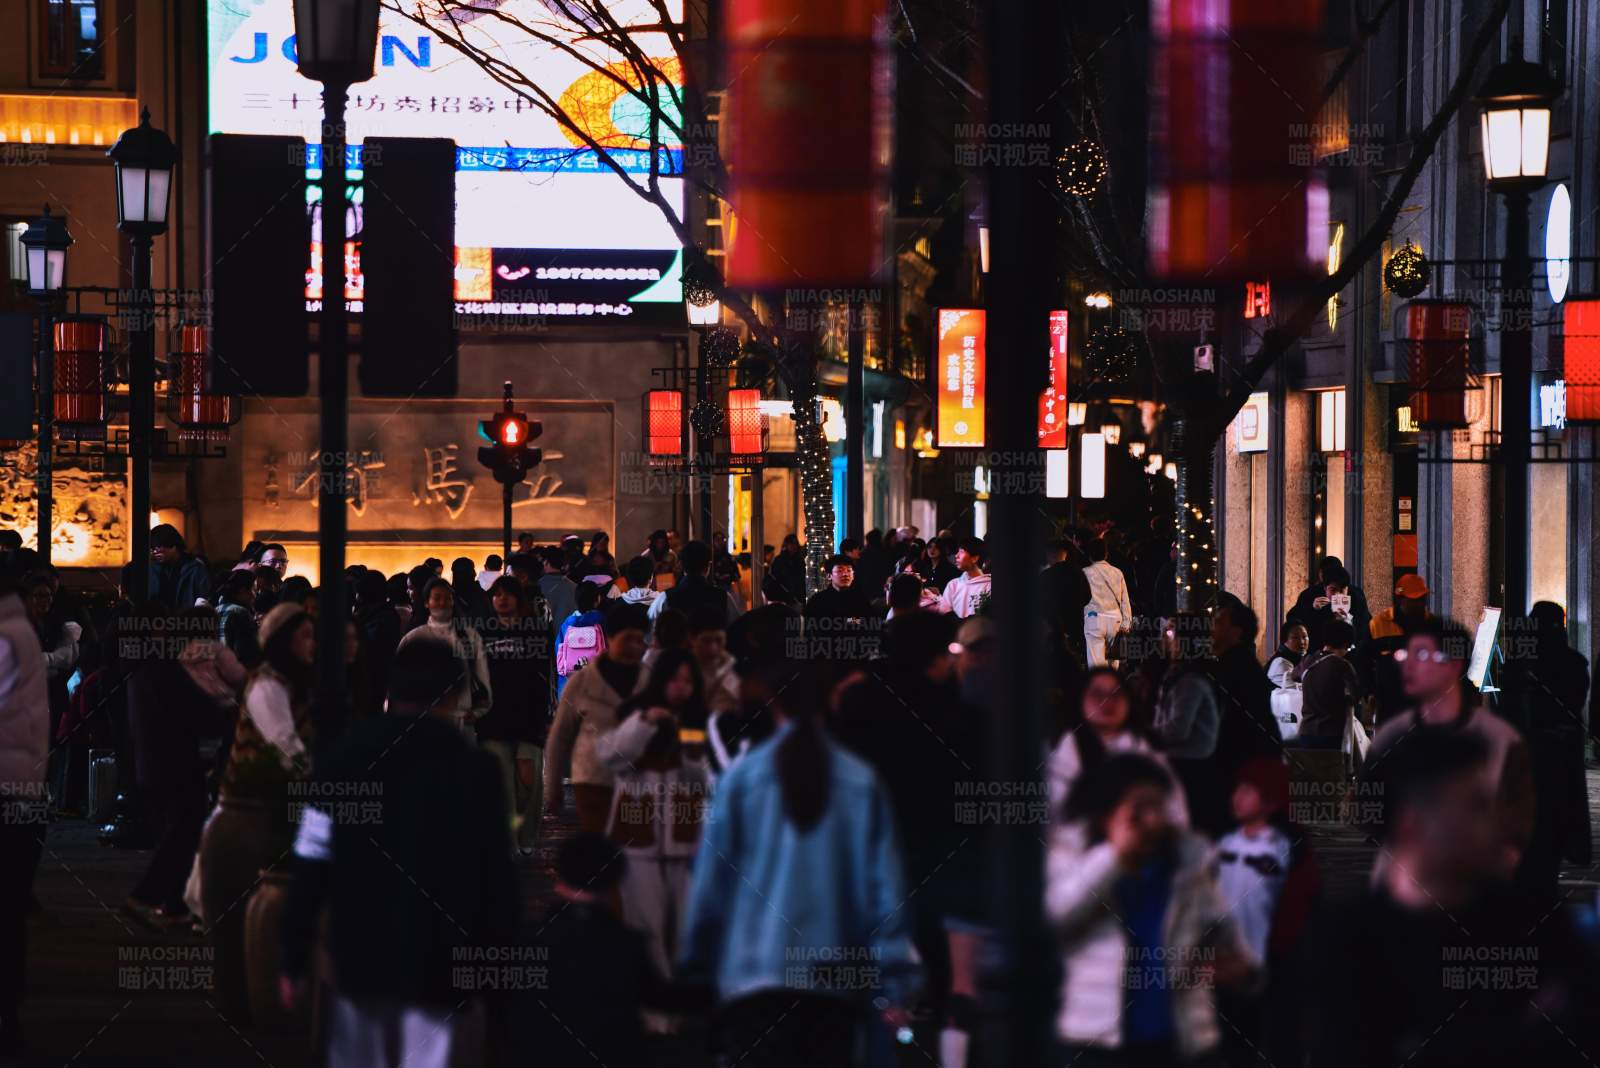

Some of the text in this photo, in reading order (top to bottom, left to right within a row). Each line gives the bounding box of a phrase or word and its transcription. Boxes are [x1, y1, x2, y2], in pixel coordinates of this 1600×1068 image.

[229, 32, 431, 68] JN
[241, 92, 534, 114] 三十坊秀招募中
